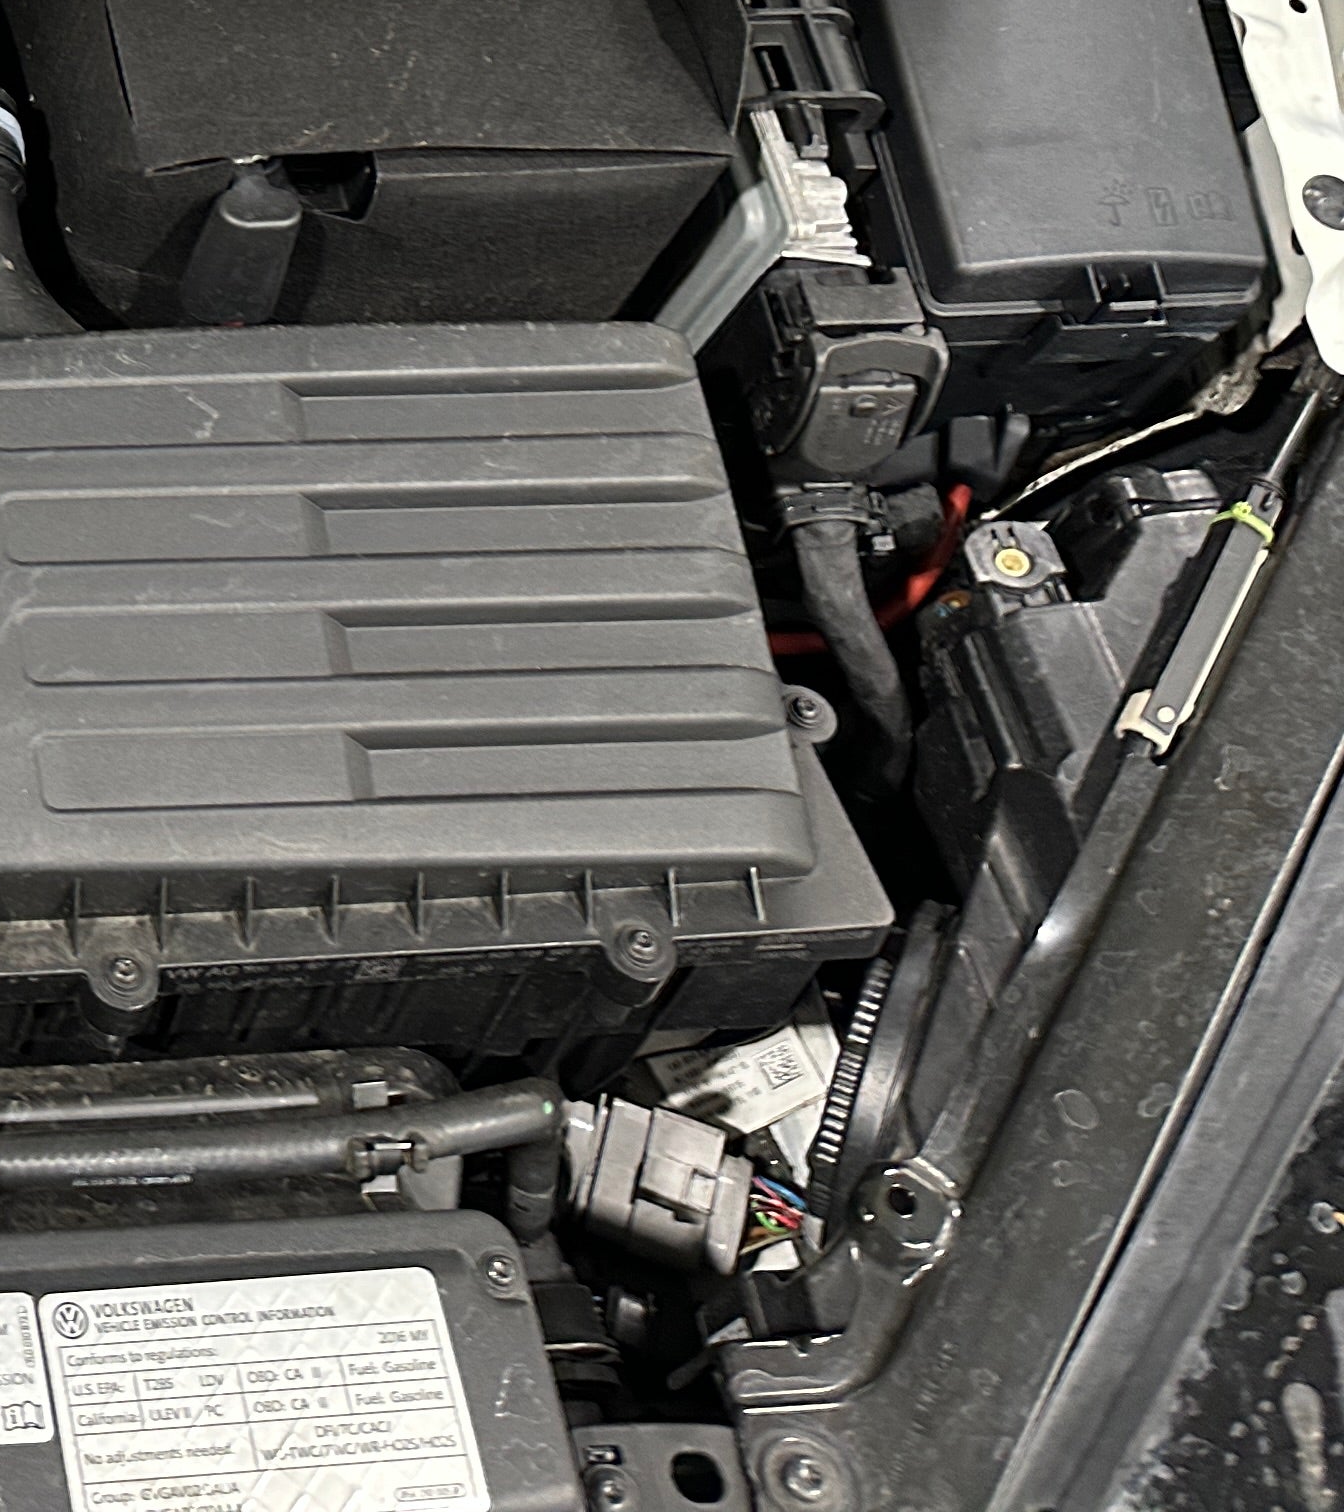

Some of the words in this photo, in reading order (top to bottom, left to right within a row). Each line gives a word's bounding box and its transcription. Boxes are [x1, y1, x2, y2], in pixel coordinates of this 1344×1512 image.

[90, 1297, 194, 1318] VOLKSWAGEN
[93, 1319, 140, 1333] VEHICLE
[142, 1315, 197, 1329] EMISSION
[200, 1311, 253, 1325] CONTROL
[255, 1305, 335, 1321] INFORMATION
[65, 1351, 127, 1366] Conforms
[127, 1350, 143, 1362] to
[347, 1361, 379, 1375] Fuel:
[381, 1357, 437, 1373] Gasoline
[354, 1391, 386, 1405] Fuel:
[388, 1387, 445, 1403] Gasoline
[83, 1452, 103, 1465] No
[104, 1446, 183, 1467] adjustments
